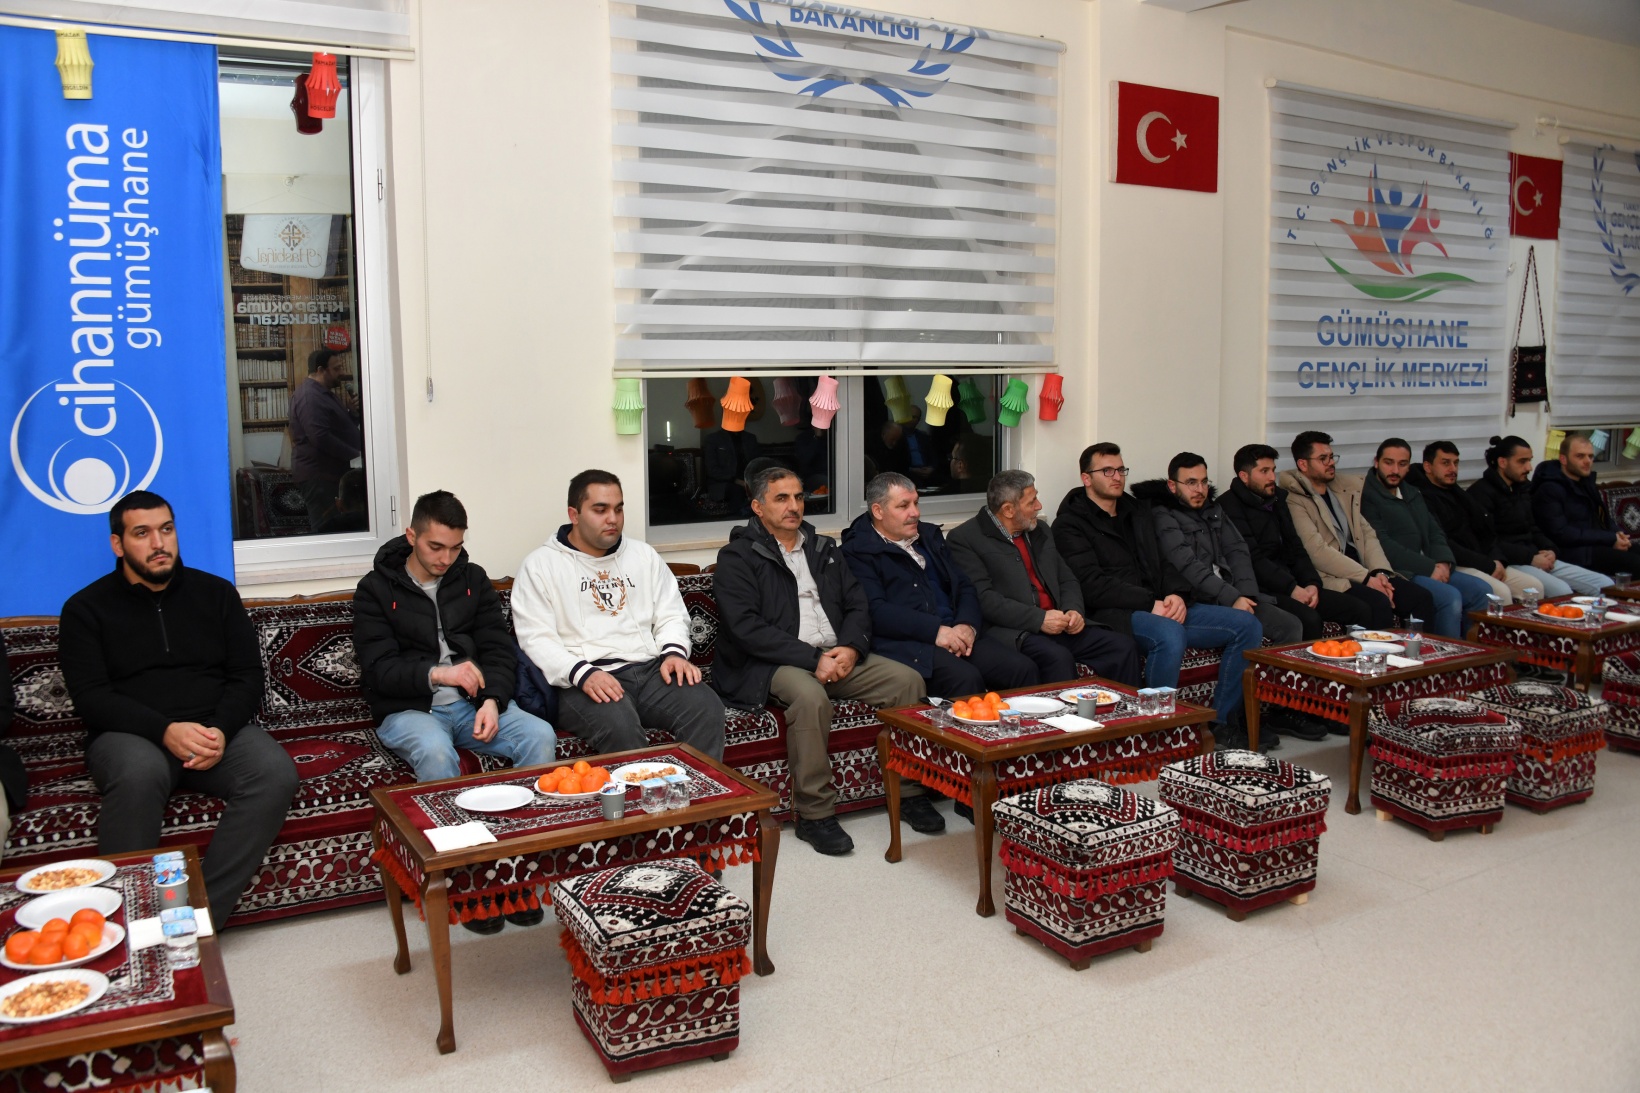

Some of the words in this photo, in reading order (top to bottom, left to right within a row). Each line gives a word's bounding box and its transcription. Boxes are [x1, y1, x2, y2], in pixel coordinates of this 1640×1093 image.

[54, 123, 117, 436] cihannüma
[113, 128, 162, 349] gümüşhane
[1297, 356, 1395, 395] GENÇLİK
[1401, 357, 1488, 387] MERKEZİ
[1317, 309, 1469, 353] GÜMÜŞHANE
